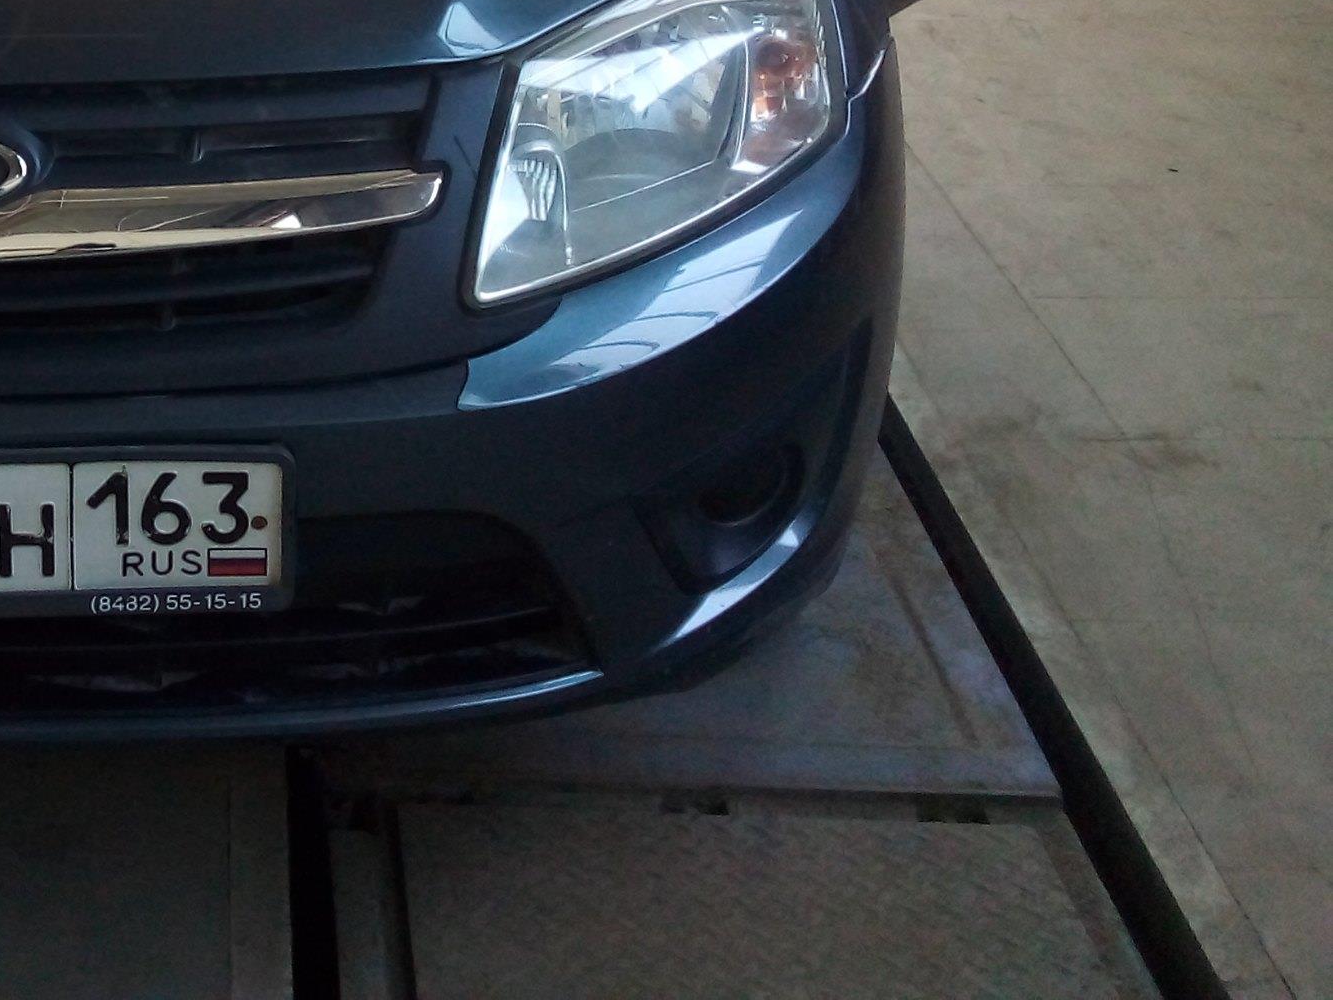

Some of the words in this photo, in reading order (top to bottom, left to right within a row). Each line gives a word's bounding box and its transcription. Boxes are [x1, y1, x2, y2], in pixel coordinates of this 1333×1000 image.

[86, 470, 250, 546] 163
[121, 549, 203, 578] RUS
[166, 592, 263, 611] 55-15-15
